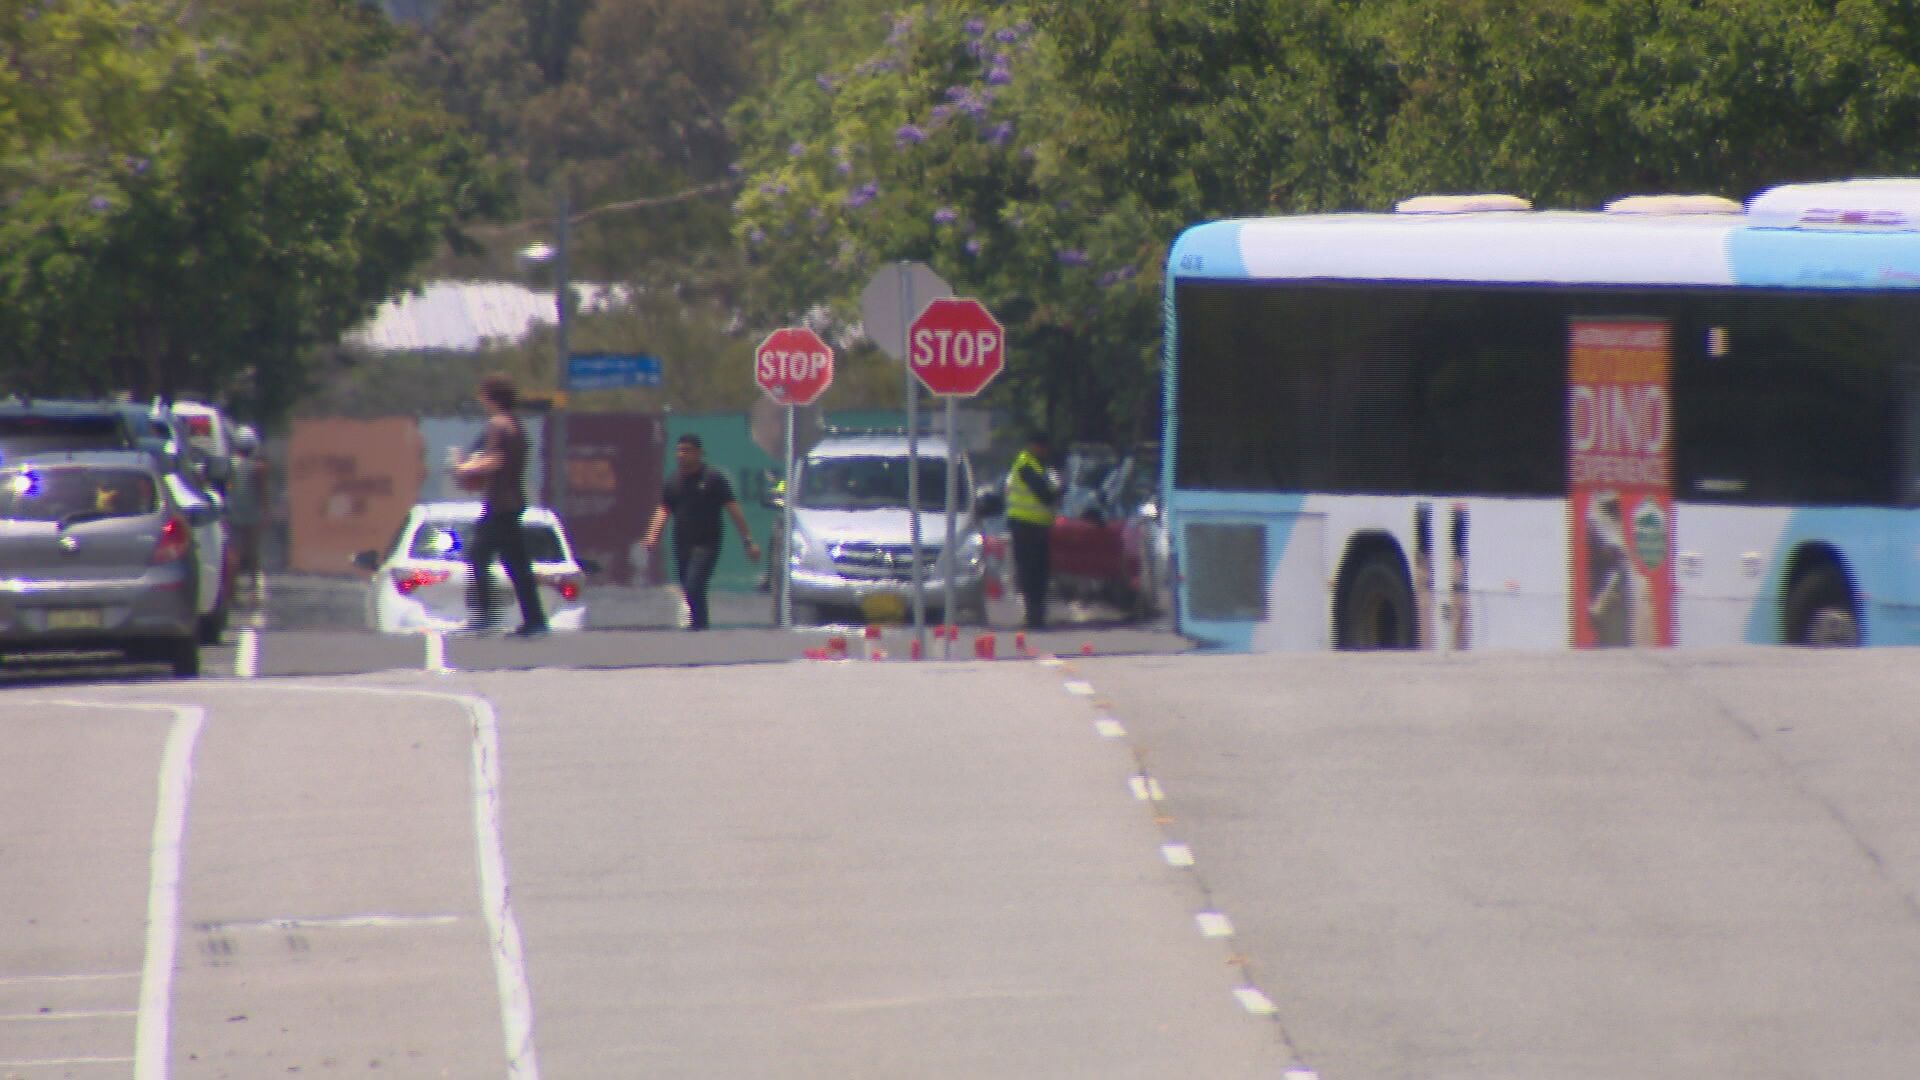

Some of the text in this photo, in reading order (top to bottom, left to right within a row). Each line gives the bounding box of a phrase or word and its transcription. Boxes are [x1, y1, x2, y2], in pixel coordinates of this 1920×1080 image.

[759, 351, 828, 381] STOP
[913, 328, 998, 367] STOP
[1570, 384, 1669, 452] DINO
